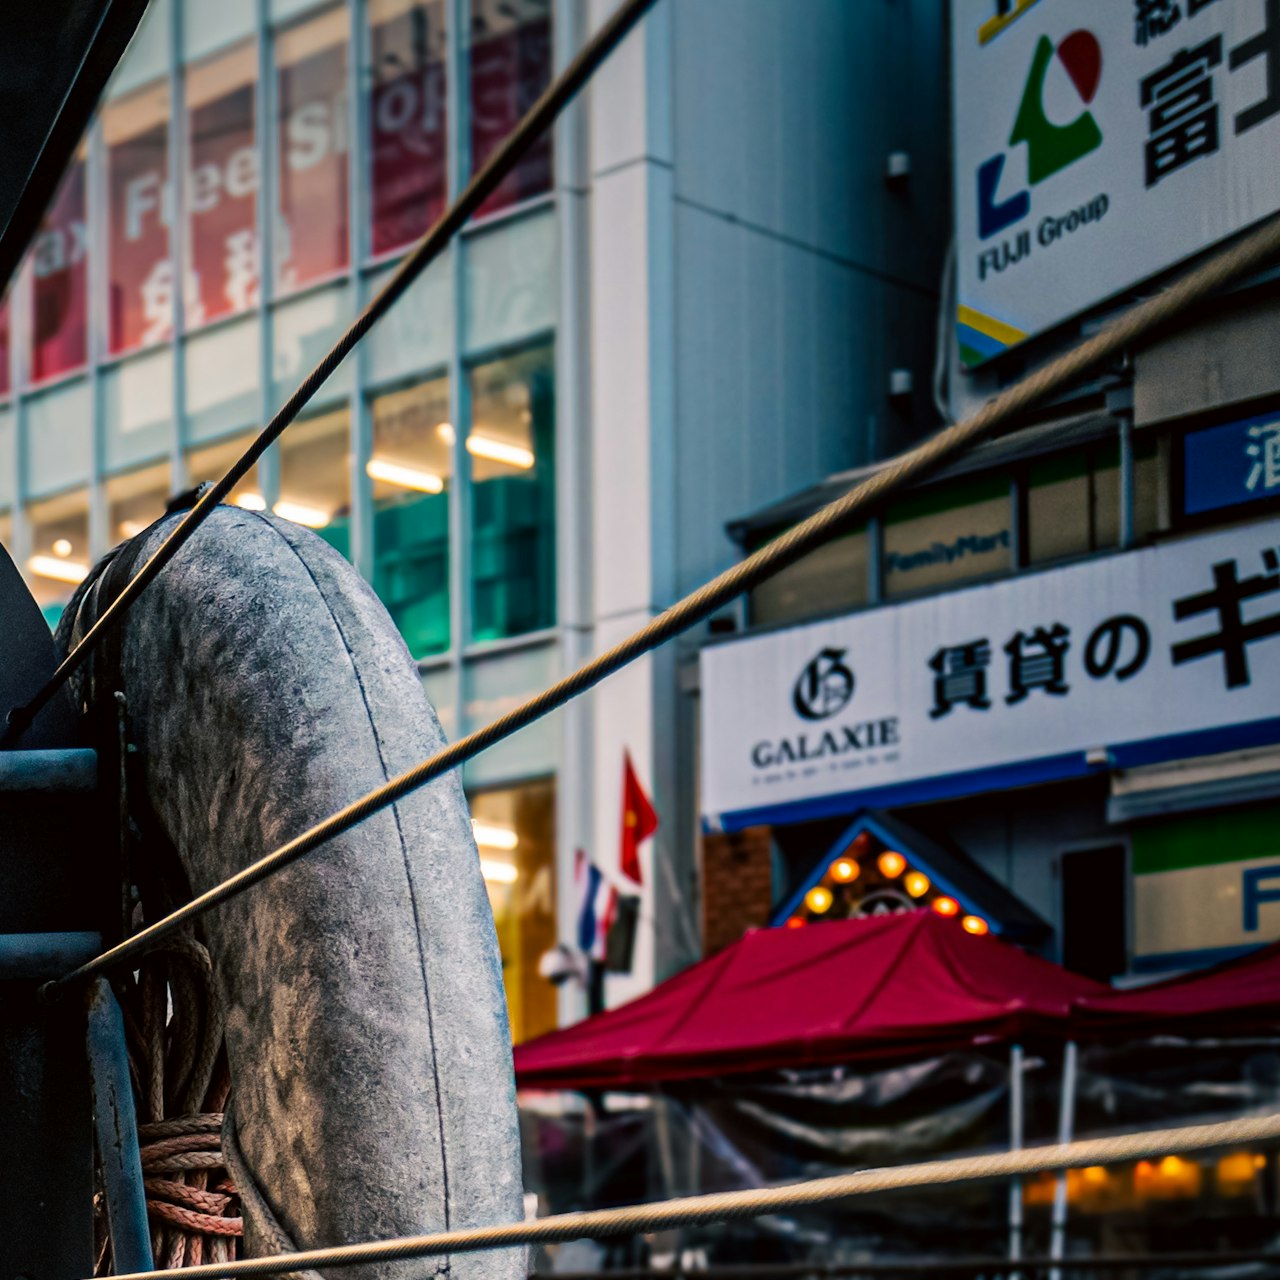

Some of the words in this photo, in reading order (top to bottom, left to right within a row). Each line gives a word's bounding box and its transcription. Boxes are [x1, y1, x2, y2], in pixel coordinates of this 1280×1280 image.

[978, 230, 1031, 282] FUJI
[1037, 193, 1110, 247] Group
[751, 716, 900, 769] GALAXIE
